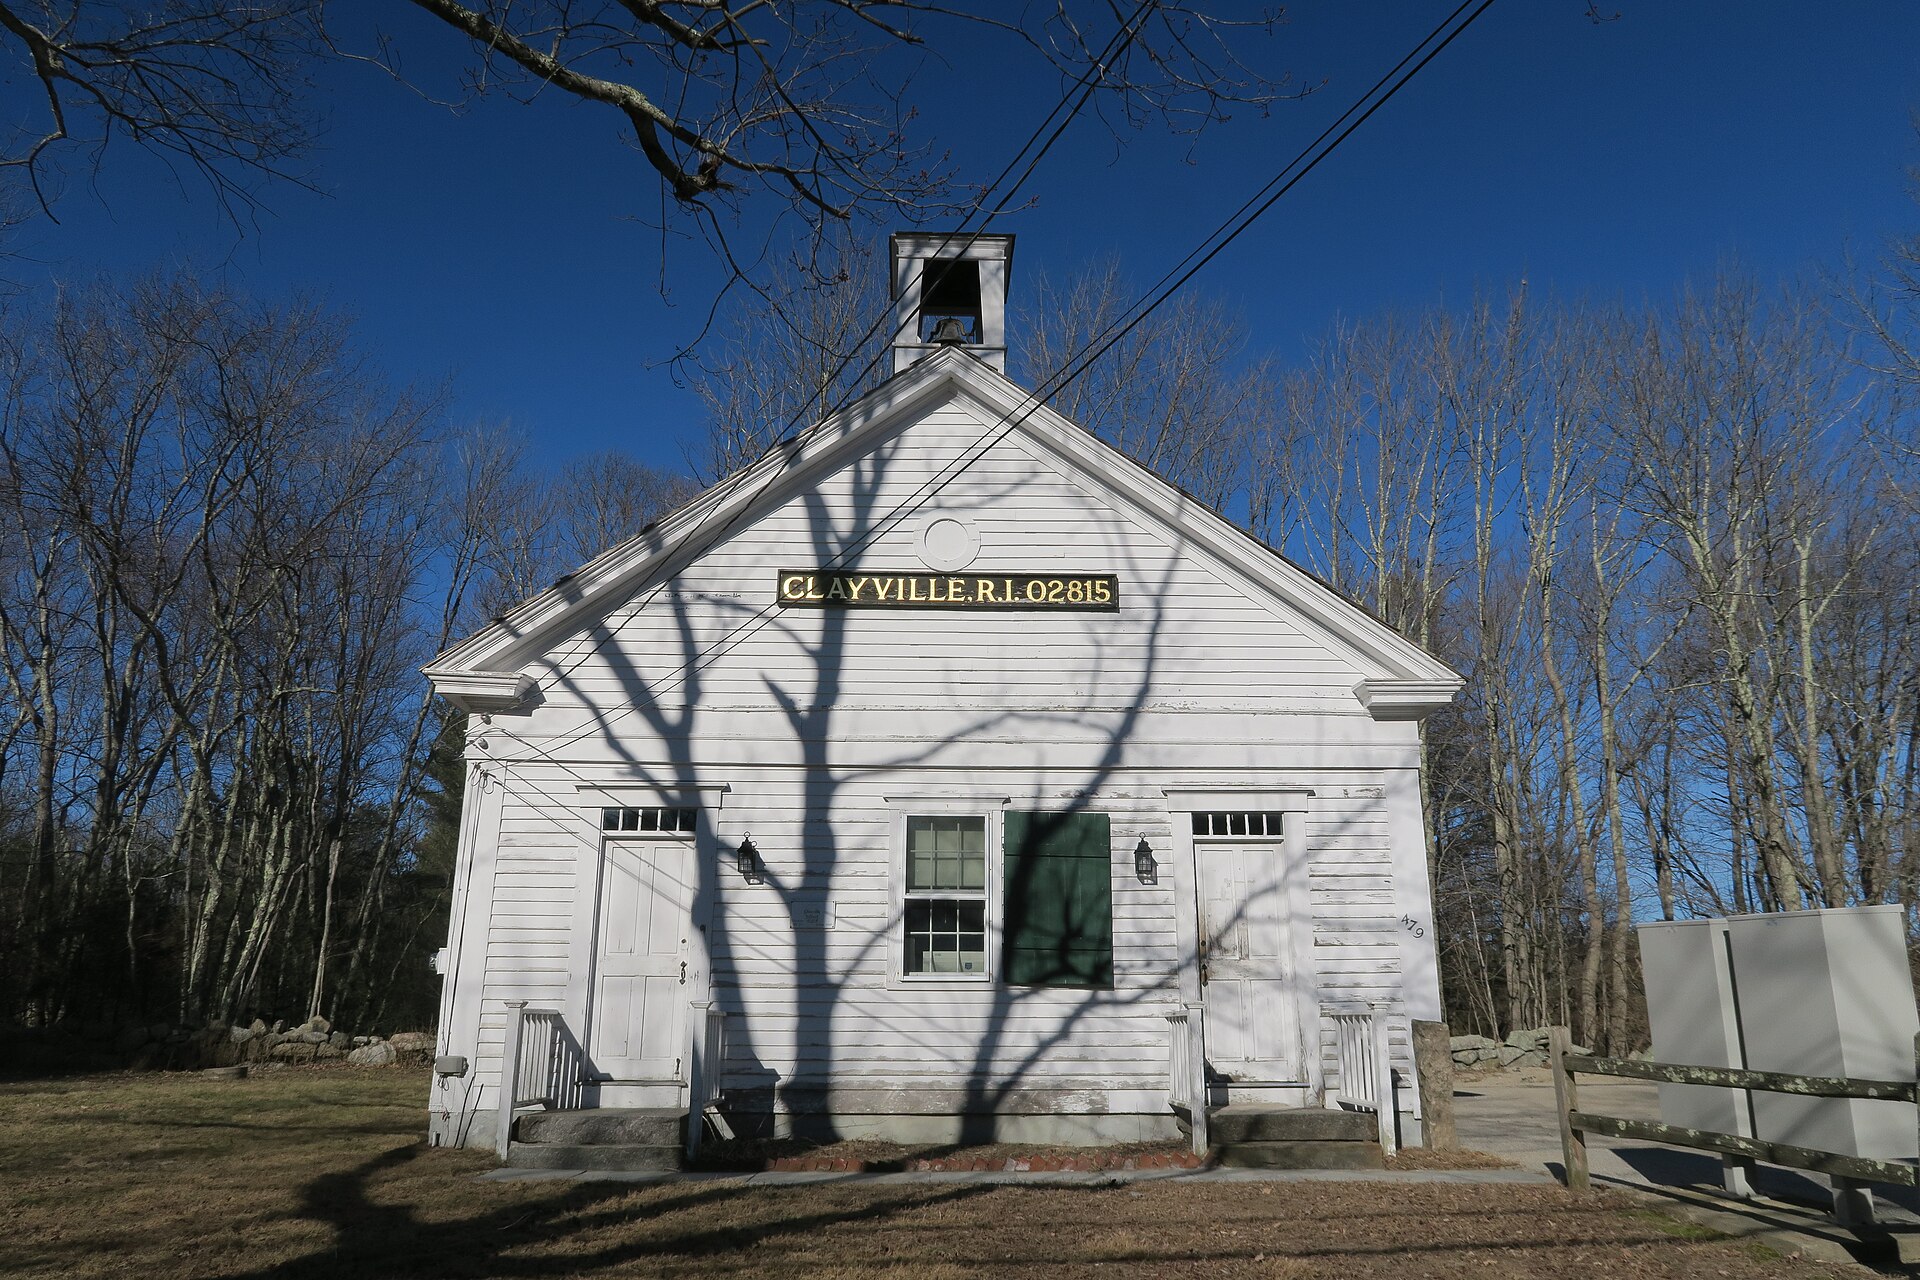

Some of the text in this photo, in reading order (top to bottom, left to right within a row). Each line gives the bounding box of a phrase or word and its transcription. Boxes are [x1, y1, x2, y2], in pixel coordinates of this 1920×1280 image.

[977, 579, 1020, 602] R.I.
[1026, 580, 1111, 602] 02815
[1401, 913, 1424, 938] 479
